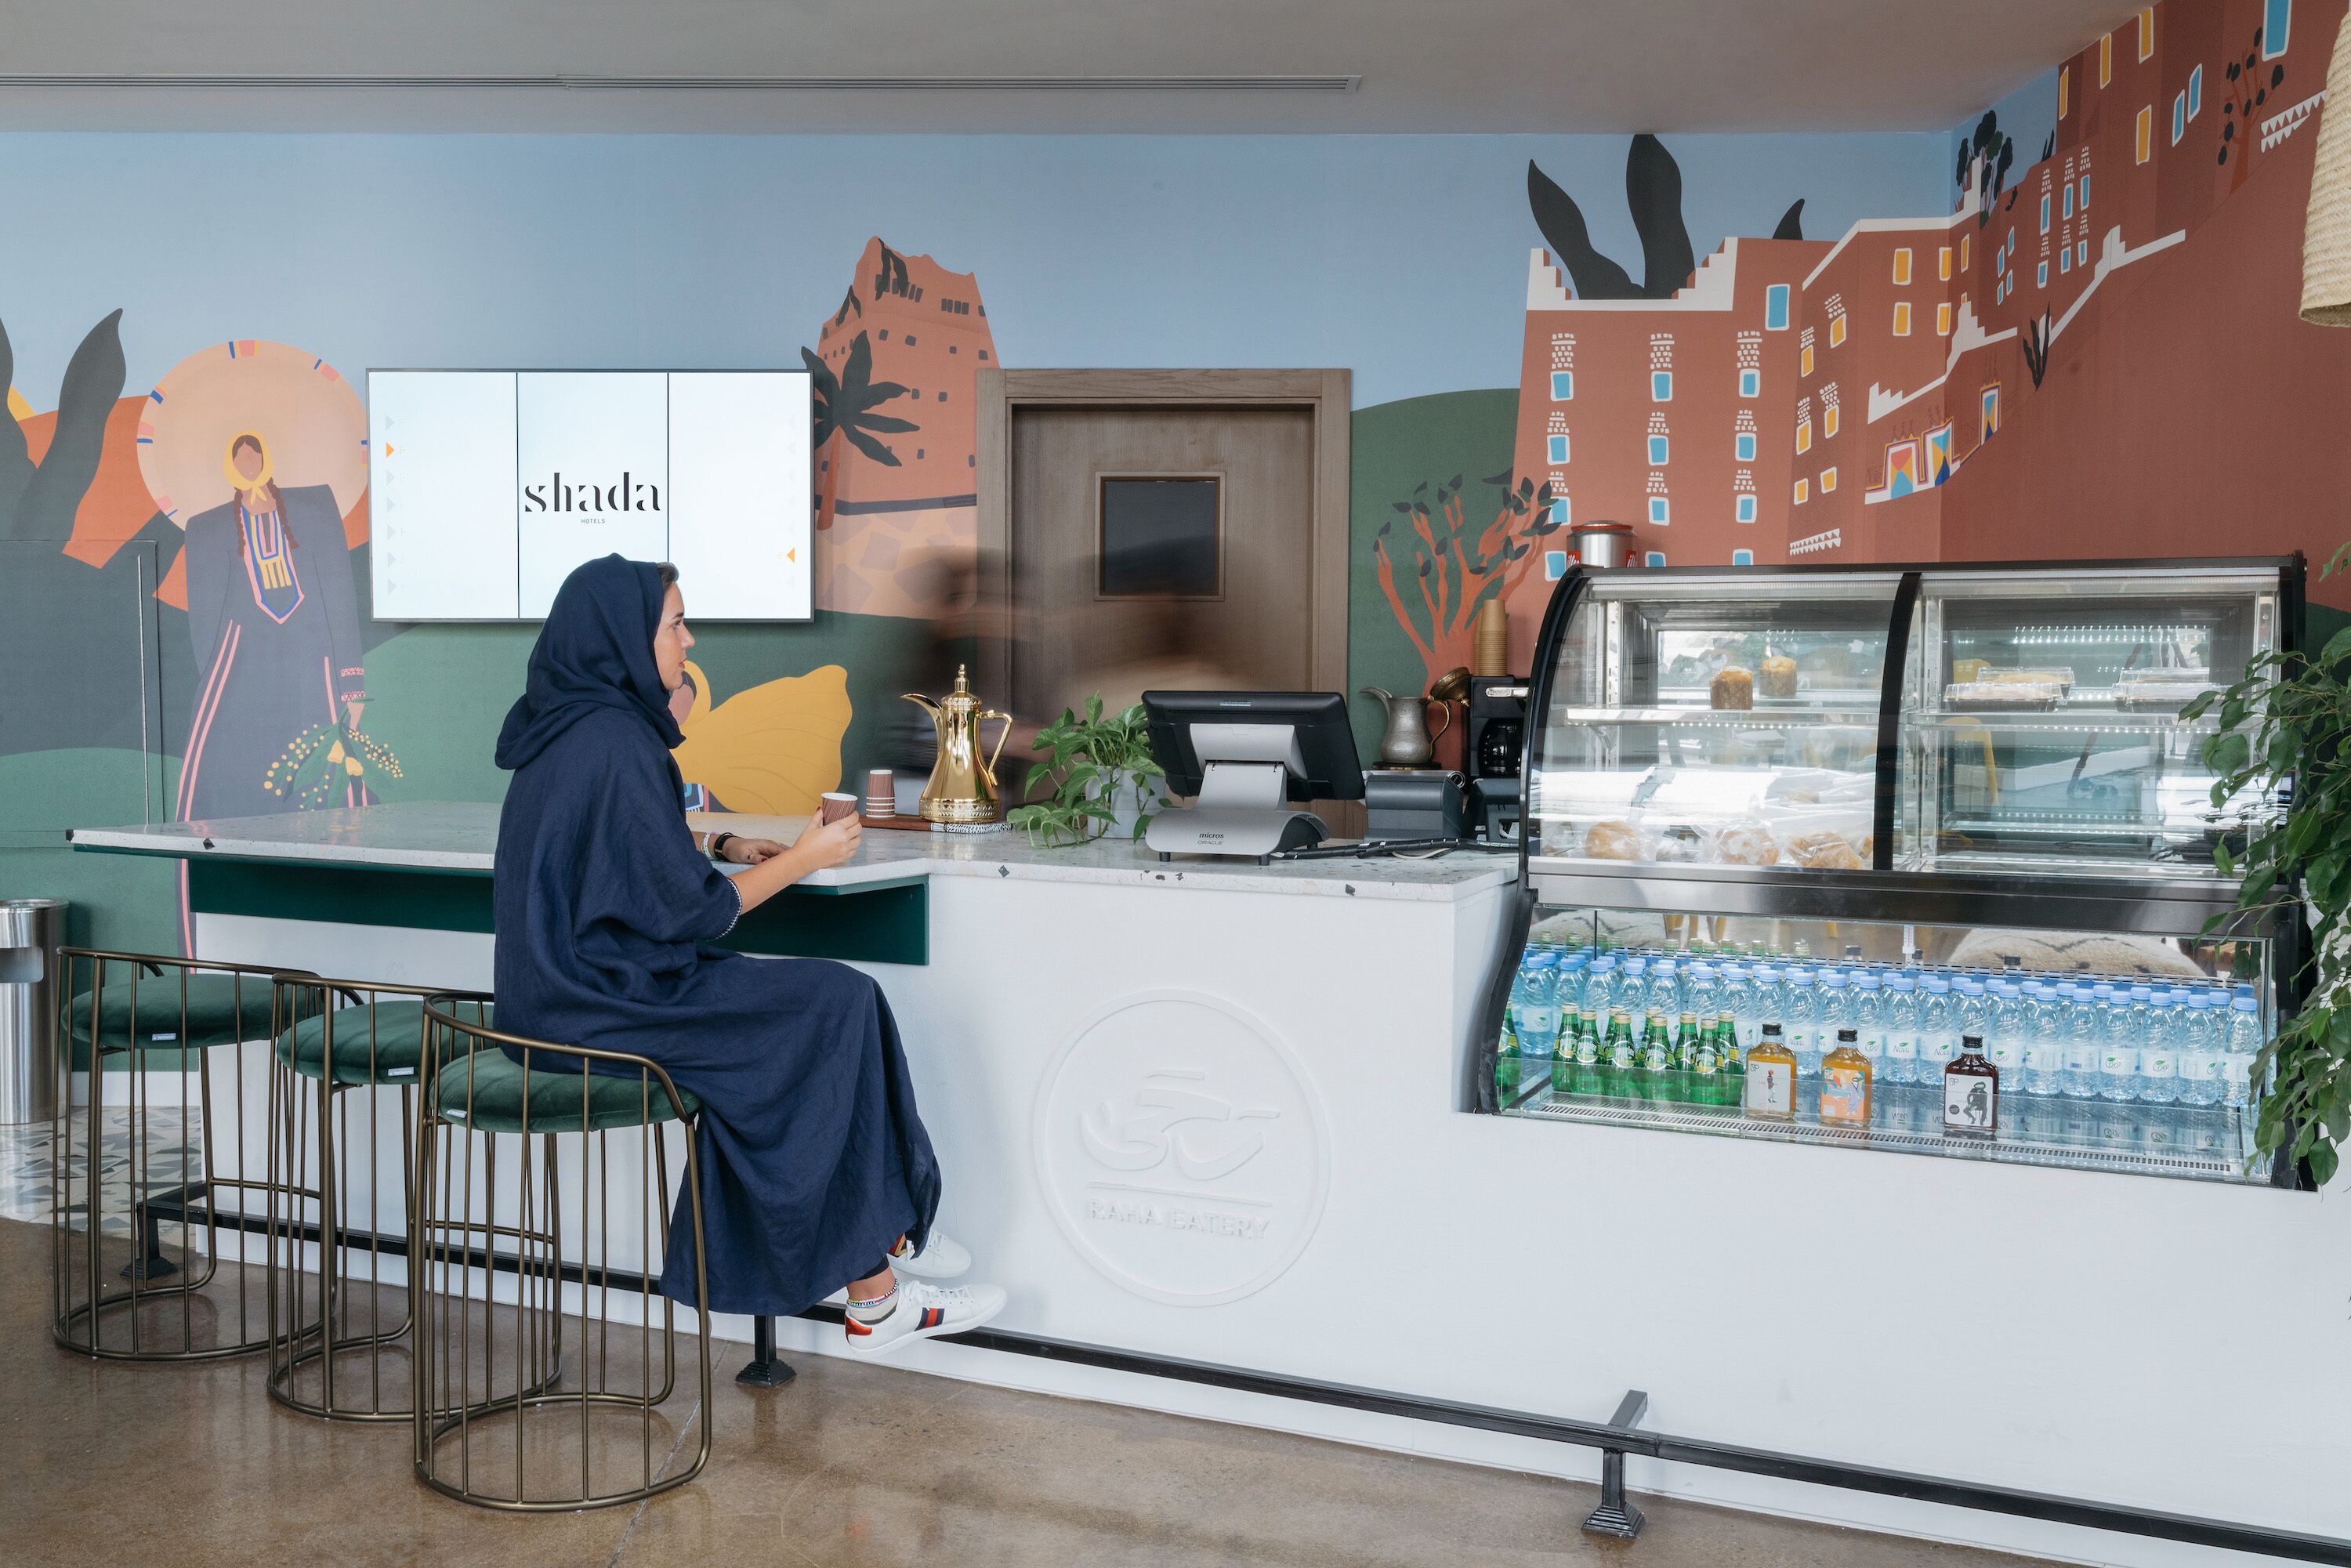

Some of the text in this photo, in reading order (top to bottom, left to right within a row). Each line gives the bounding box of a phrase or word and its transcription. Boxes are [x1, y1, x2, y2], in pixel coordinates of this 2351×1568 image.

[525, 472, 661, 512] shada
[1893, 1045, 1910, 1053] Nova
[1089, 1198, 1271, 1240] RAHA EATERY
